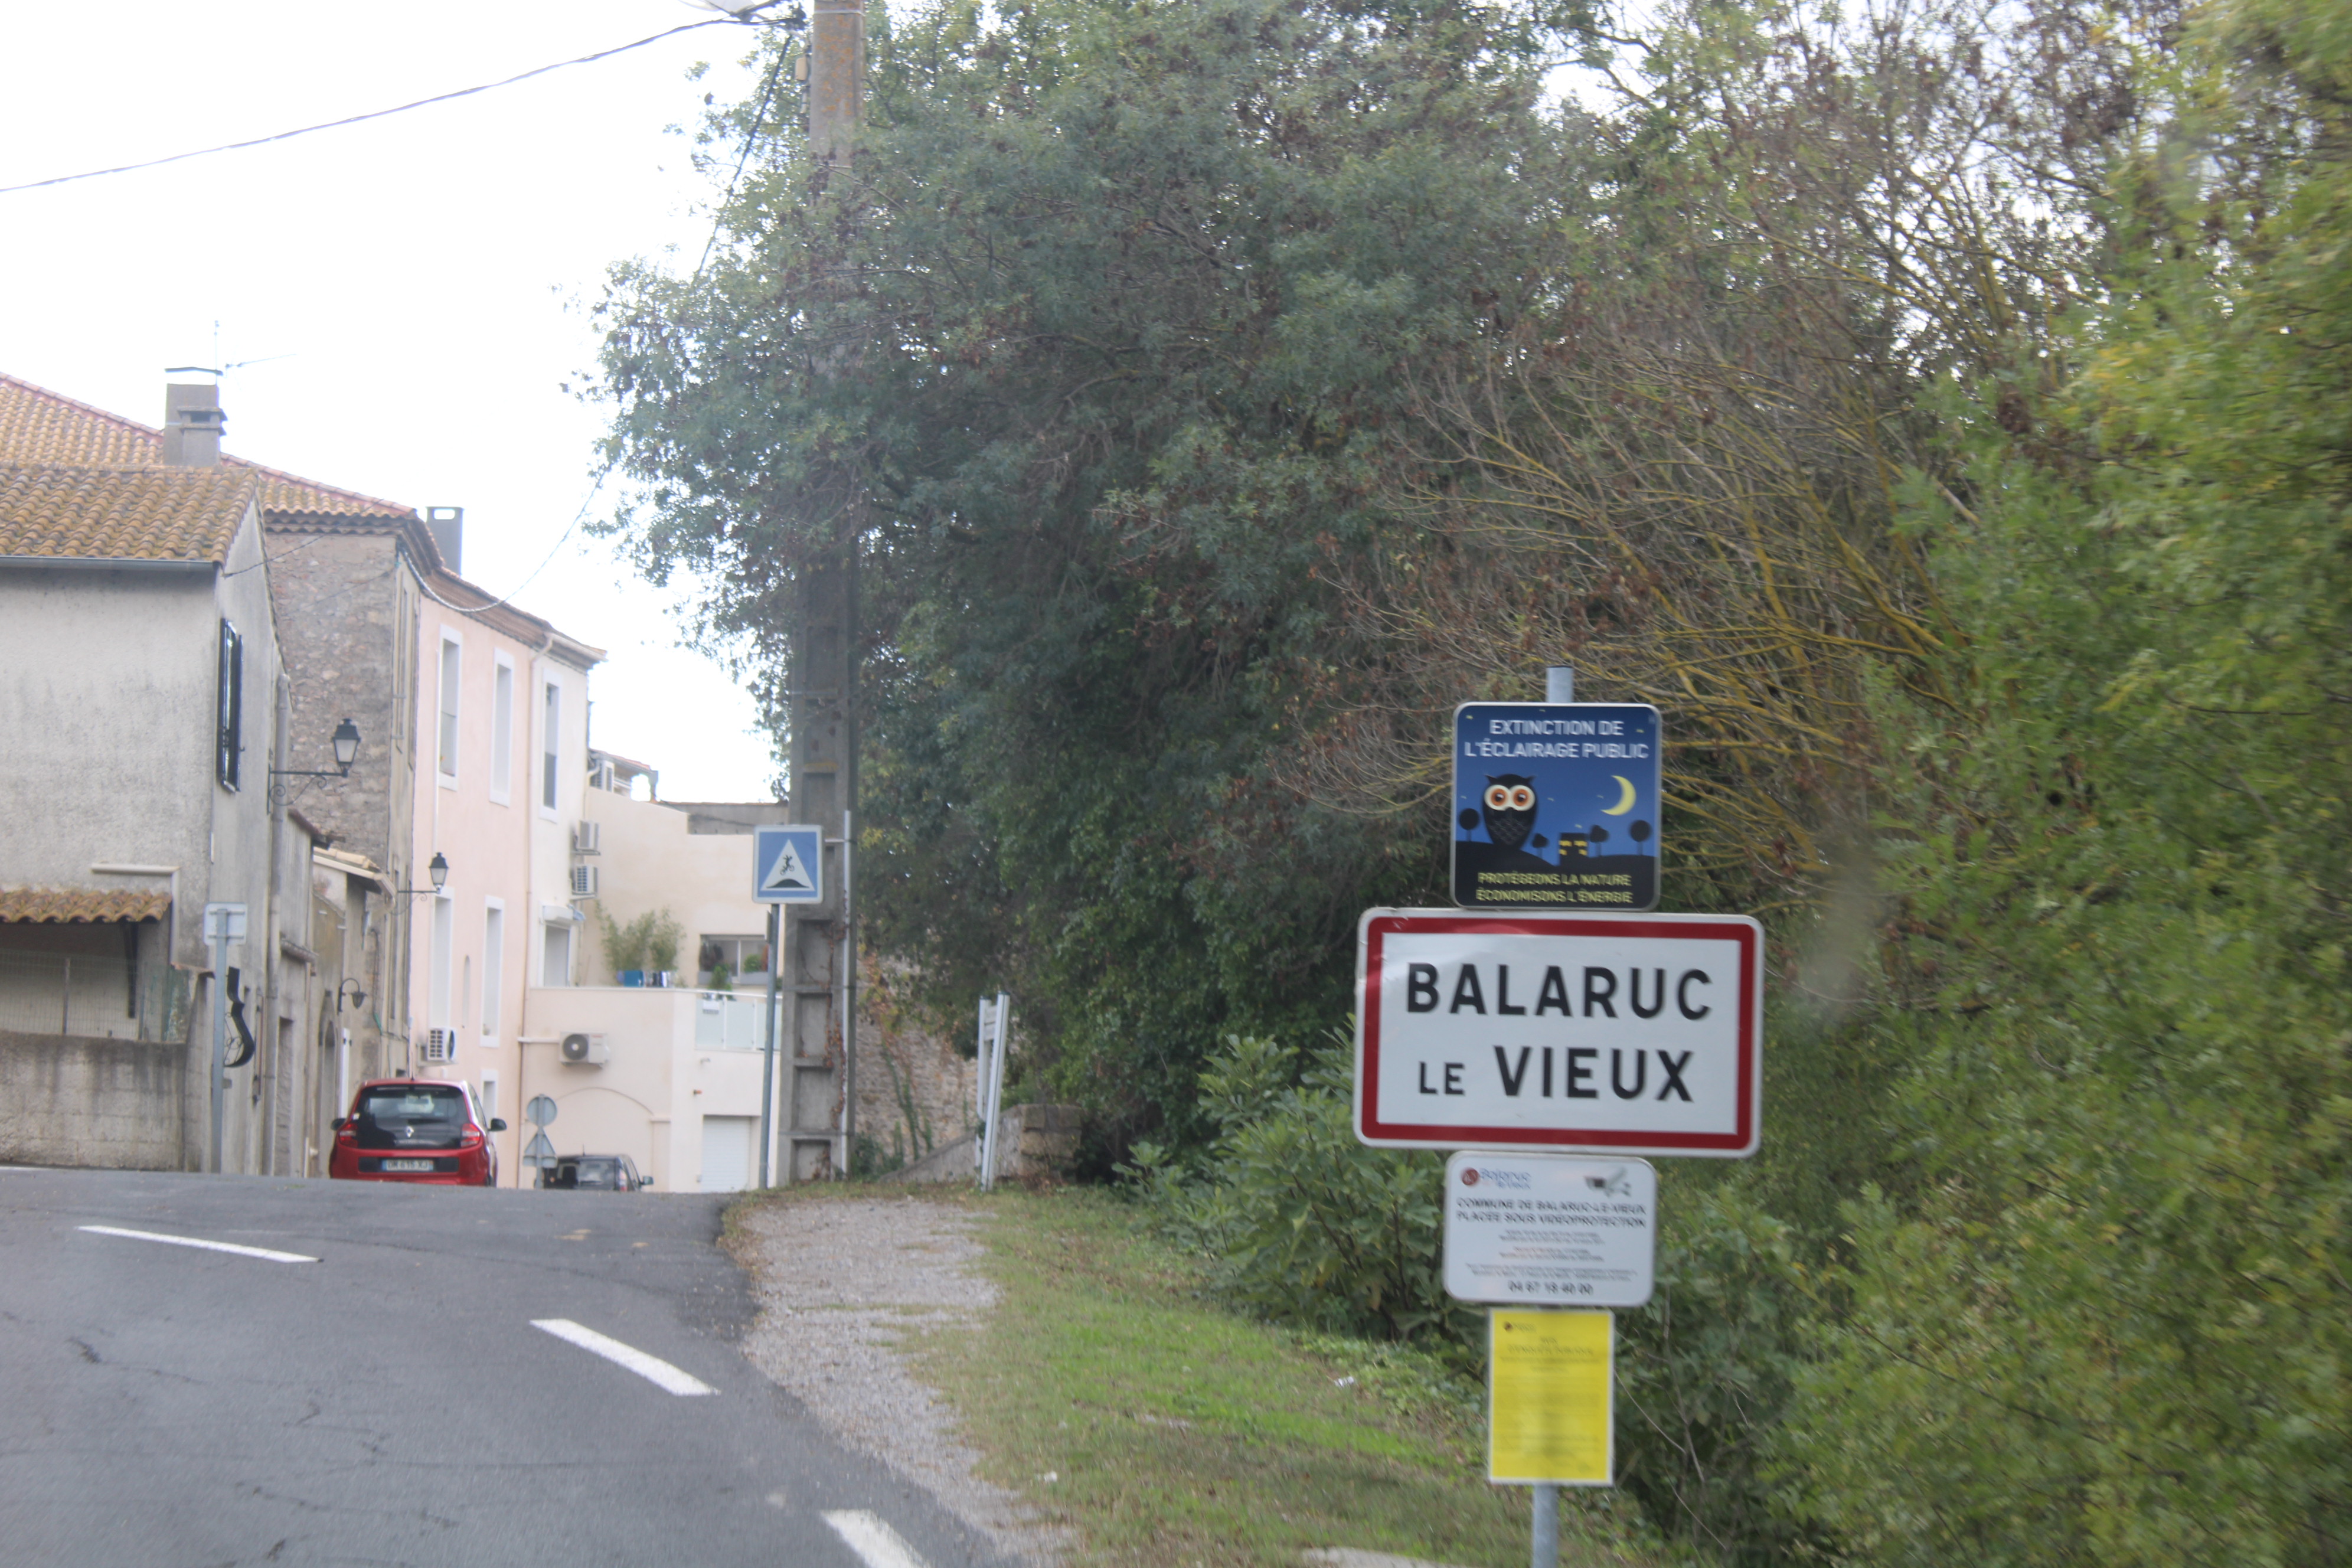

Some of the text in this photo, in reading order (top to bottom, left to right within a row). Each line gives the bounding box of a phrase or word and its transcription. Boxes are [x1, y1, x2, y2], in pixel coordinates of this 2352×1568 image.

[1489, 720, 1624, 736] EXTINCTION DE
[1464, 737, 1649, 759] L'ÉCLAIRAGE PUBLIC
[1478, 870, 1632, 886] PROTÉGEONS LA NATURE
[1476, 887, 1634, 903] ÉCONOMISONS L'ÉNERGIE
[1407, 962, 1712, 1020] BALARUC
[1419, 1046, 1694, 1102] LE VIEUX
[1456, 1197, 1514, 1209] COMMUNE
[1517, 1200, 1533, 1210] DE
[1504, 1212, 1536, 1224] SOUS
